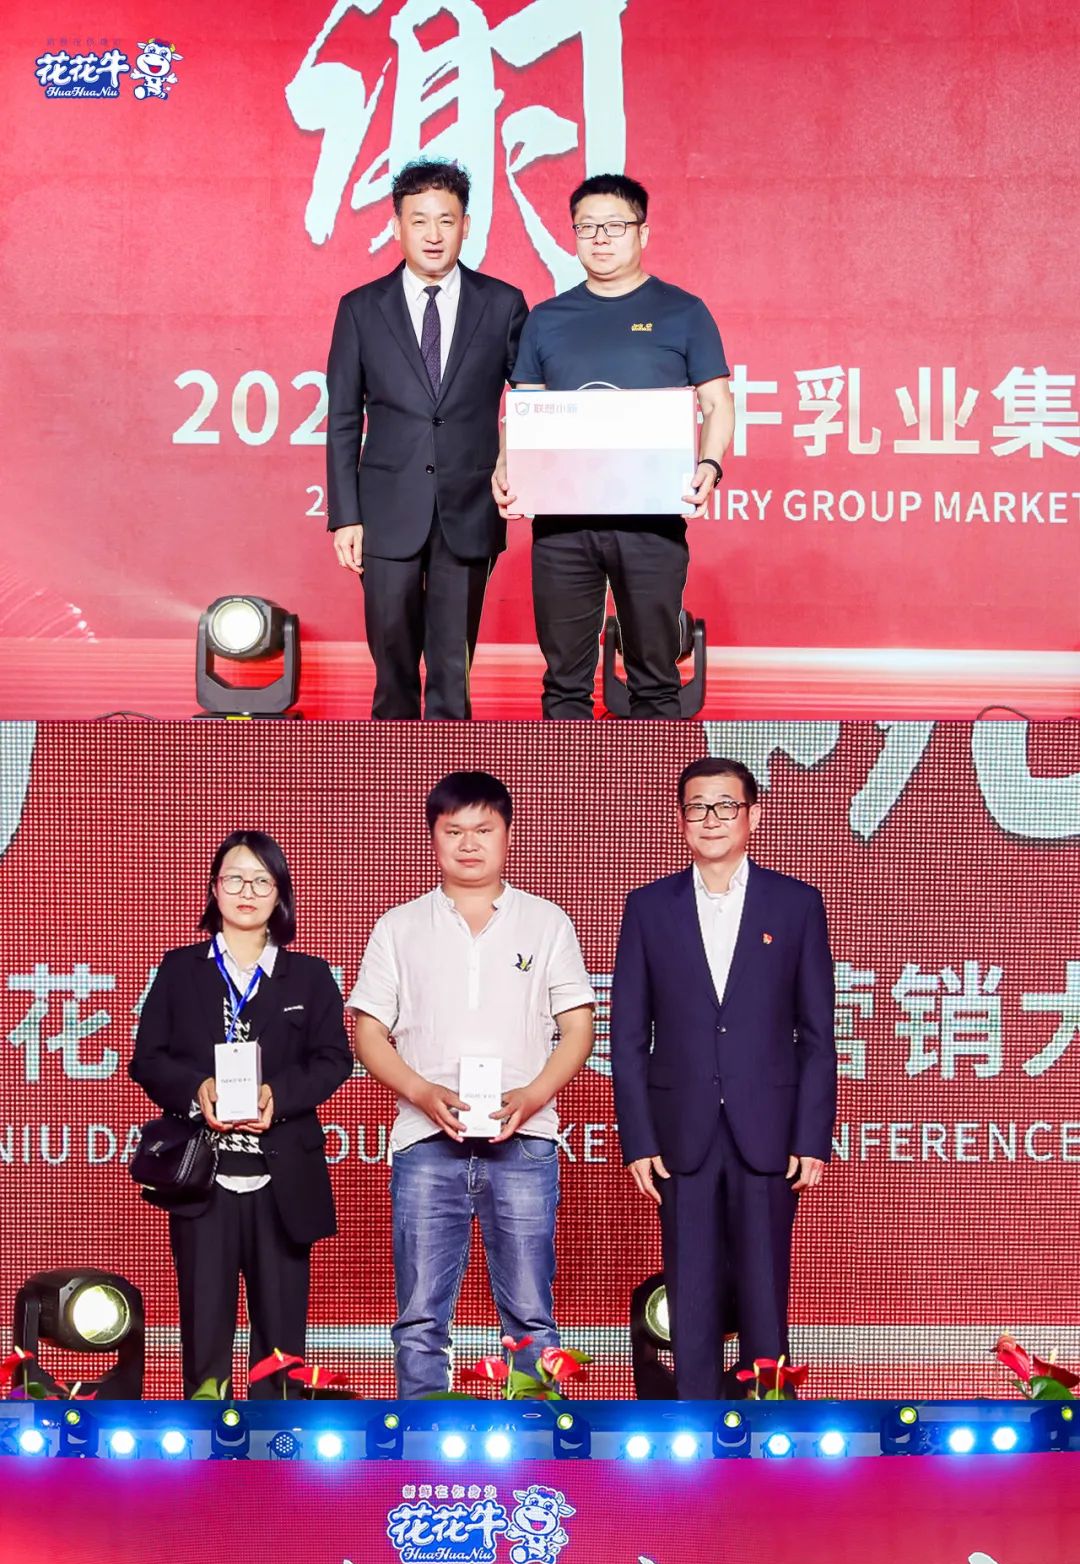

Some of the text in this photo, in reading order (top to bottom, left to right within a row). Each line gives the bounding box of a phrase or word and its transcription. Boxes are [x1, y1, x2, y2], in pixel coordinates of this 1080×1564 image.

[35, 49, 130, 88] 花花牛
[704, 489, 773, 521] IRY
[783, 489, 922, 522] GROUP
[391, 1501, 507, 1549] 花花牛
